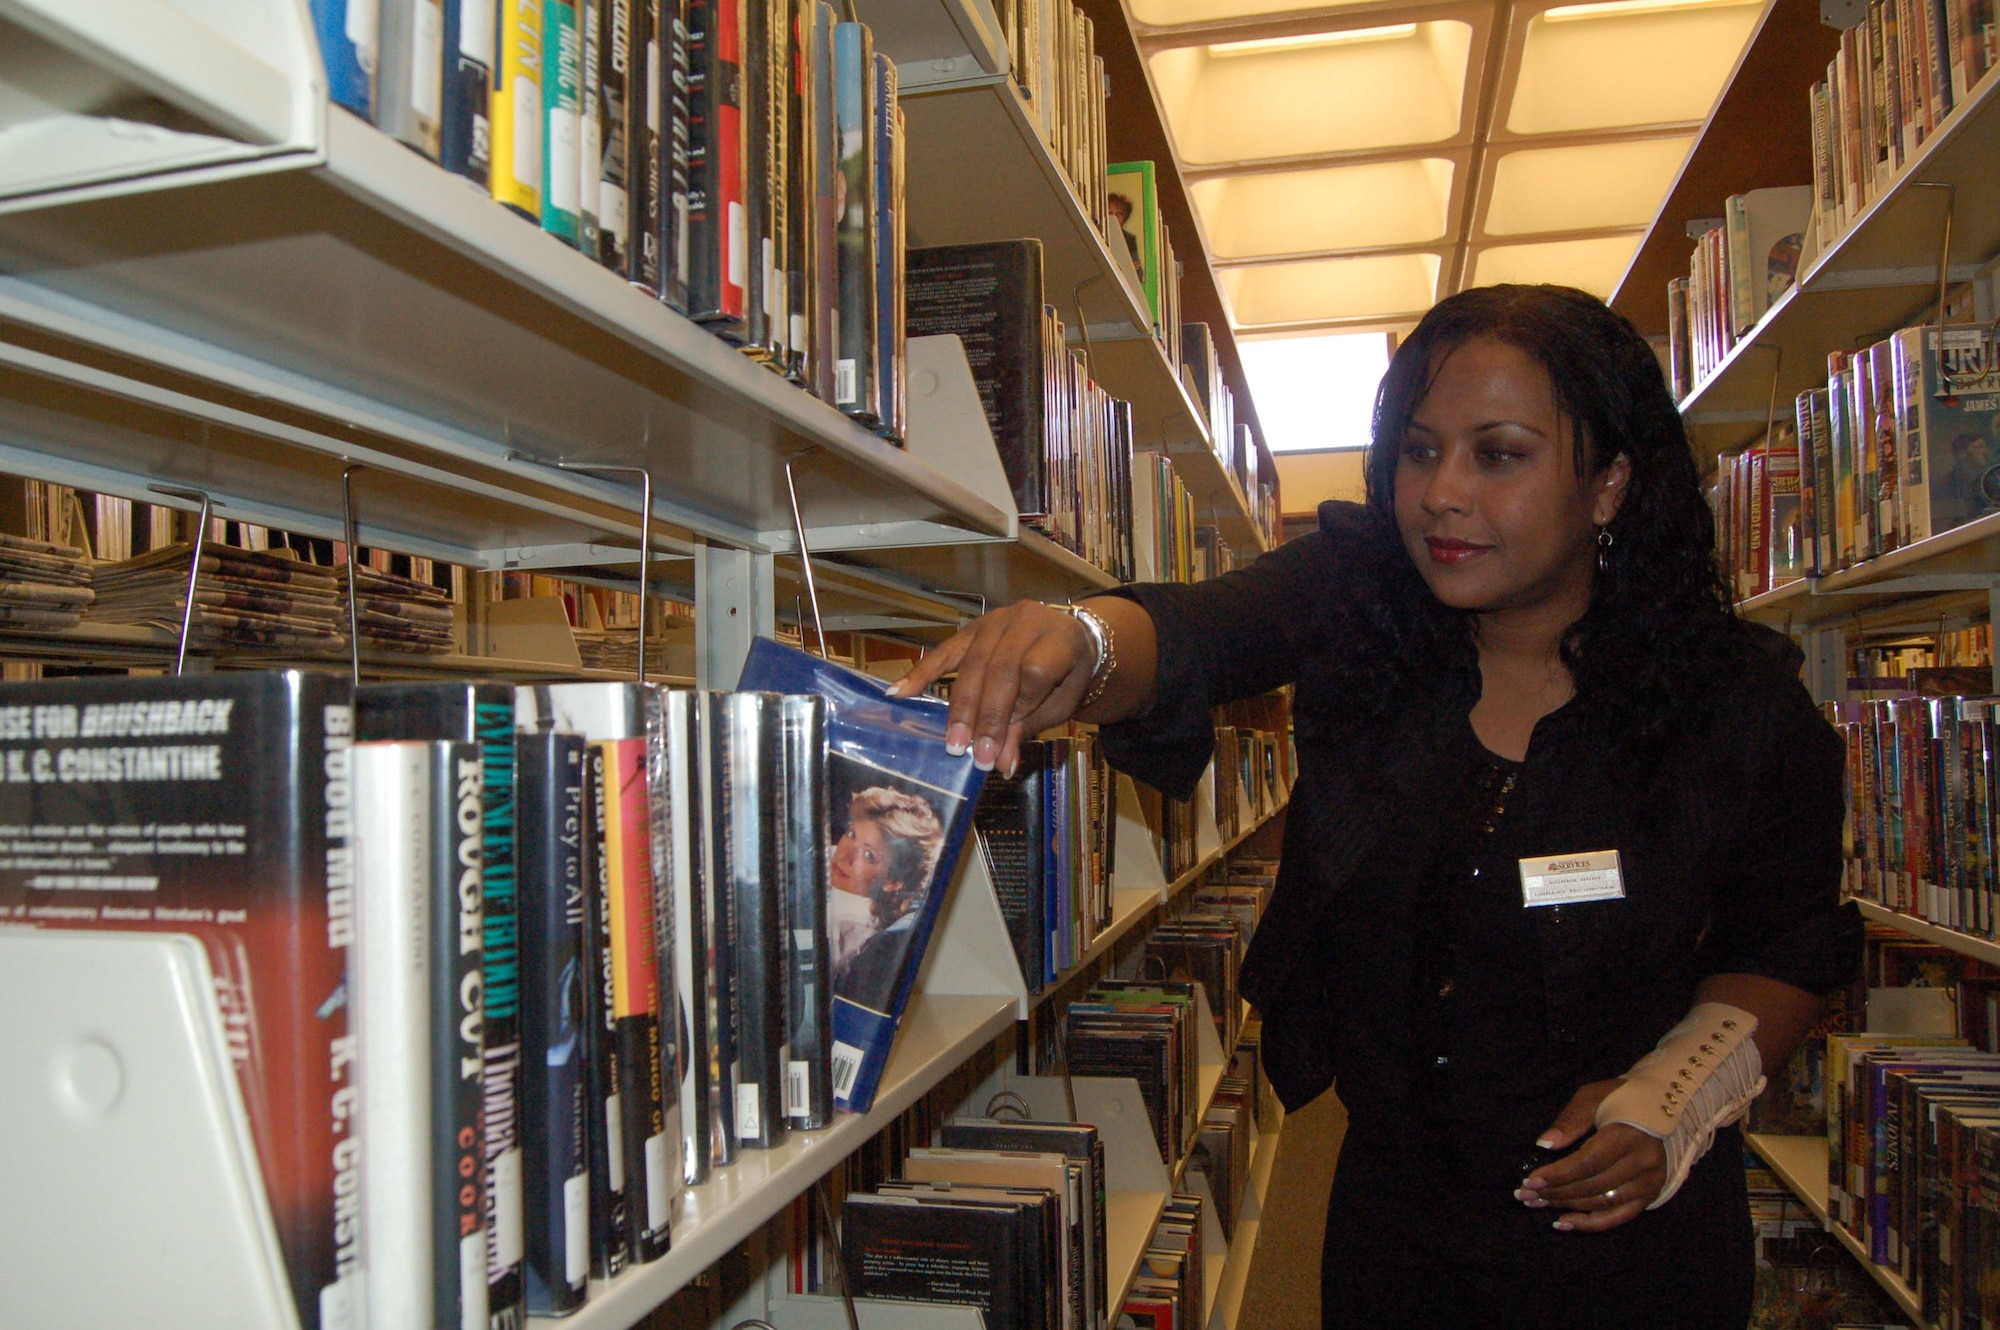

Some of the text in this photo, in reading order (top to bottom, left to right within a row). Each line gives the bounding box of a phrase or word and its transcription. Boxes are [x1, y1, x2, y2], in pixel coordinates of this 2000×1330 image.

[585, 4, 598, 40] MAX
[585, 42, 598, 90] ALLAN
[1798, 397, 1810, 440] DUNE
[1816, 409, 1828, 457] DUNE
[34, 704, 78, 739] FOR
[80, 699, 233, 738] BRUSHBACK
[32, 749, 57, 784] C.
[58, 745, 222, 783] CONSTANTINE
[324, 704, 352, 839] Blood
[560, 785, 581, 848] Prey
[593, 755, 607, 832] OTHER
[458, 757, 483, 956] ROUGH
[566, 856, 578, 878] to
[1558, 860, 1591, 870] SERVICES
[326, 848, 354, 948] Mud
[565, 882, 585, 926] All
[459, 969, 483, 1082] CUT
[331, 1034, 358, 1082] K.
[648, 1026, 661, 1100] MANGO
[331, 1086, 359, 1133] C.
[1887, 1122, 1899, 1171] JONES
[458, 1126, 476, 1236] COOK
